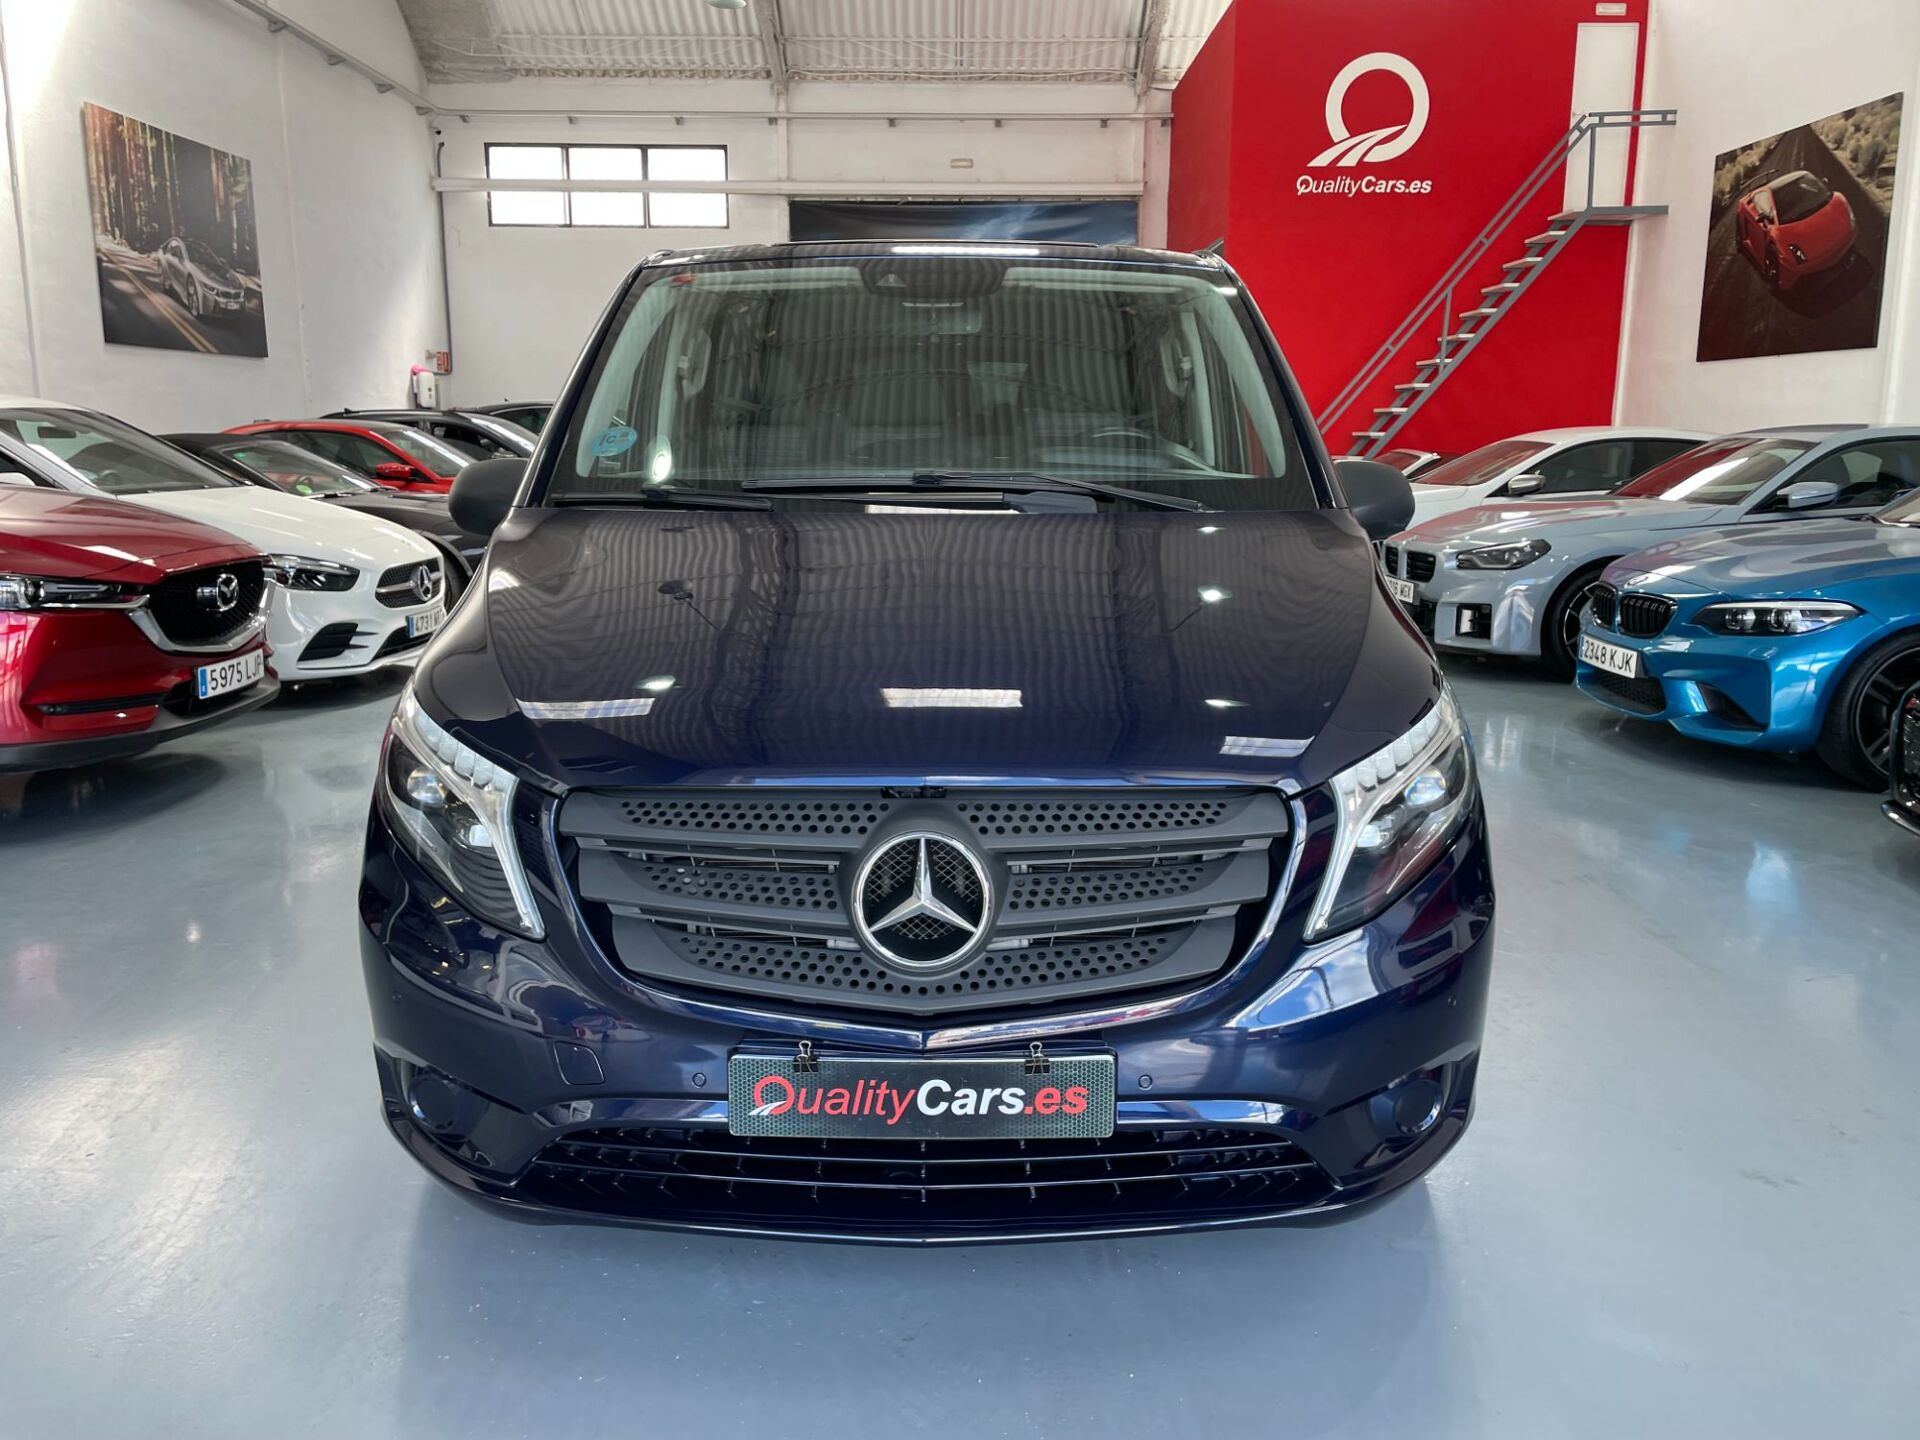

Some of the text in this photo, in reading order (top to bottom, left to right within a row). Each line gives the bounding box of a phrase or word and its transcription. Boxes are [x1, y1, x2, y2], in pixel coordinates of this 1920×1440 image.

[1296, 175, 1432, 198] QualityCars.es
[1584, 640, 1633, 673] 2348 KJK
[209, 662, 243, 691] 5975
[749, 1075, 1088, 1125] QualityCars.es
